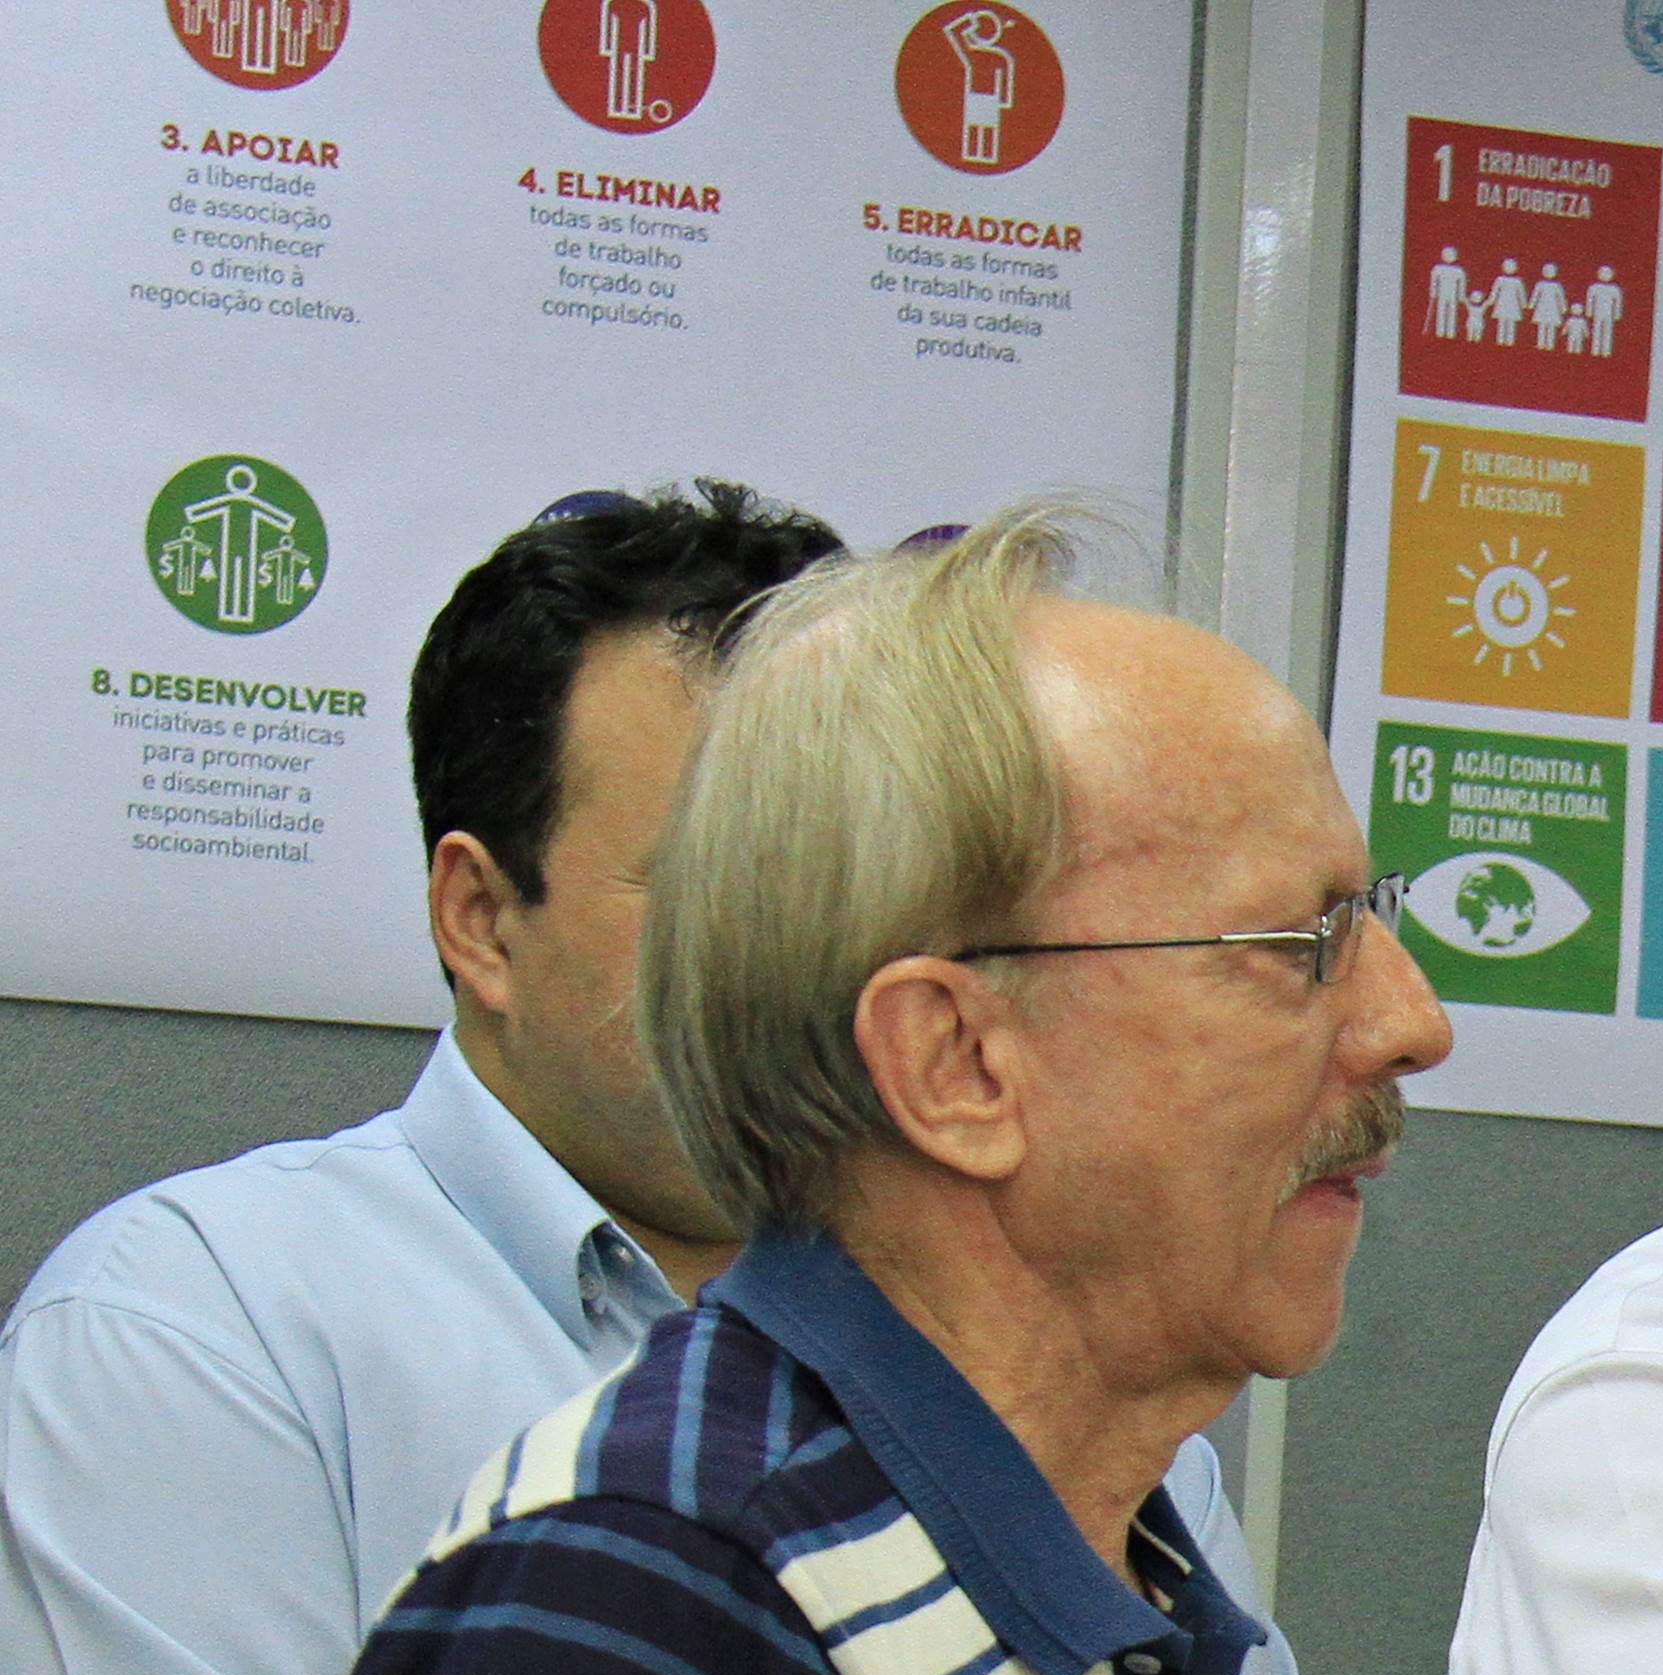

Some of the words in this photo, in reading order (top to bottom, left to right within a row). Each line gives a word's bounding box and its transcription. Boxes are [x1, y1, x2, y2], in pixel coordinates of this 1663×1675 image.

[161, 124, 189, 151] 3.
[201, 128, 339, 169] APOIAR
[187, 169, 199, 184] a
[207, 165, 316, 196] liberdade
[518, 168, 545, 193] 4.
[557, 171, 720, 213] ELIMINAR
[1434, 144, 1453, 202] 1
[169, 194, 196, 214] de
[204, 200, 332, 231] associação
[1476, 181, 1504, 208] DA
[1506, 186, 1593, 219] POBREZA
[173, 228, 186, 244] e
[194, 229, 326, 258] reconhecer
[530, 206, 591, 229] todas
[598, 216, 623, 233] as
[630, 214, 709, 243] formas
[862, 203, 889, 232] 5.
[898, 207, 1083, 253] ERRADICAR
[191, 260, 204, 276] o
[211, 258, 284, 284] direito
[554, 238, 581, 259] de
[589, 241, 681, 269] trabalho
[887, 243, 945, 268] todas
[950, 254, 975, 271] as
[982, 252, 1058, 280] formas
[559, 266, 641, 297] forçado
[649, 281, 676, 298] ou
[870, 271, 897, 292] de
[902, 274, 993, 302] trabalho
[999, 284, 1072, 310] infantil
[130, 283, 261, 316] negociação
[269, 297, 361, 323] coletiva.
[542, 299, 688, 330] compulsório.
[897, 303, 923, 324] da
[929, 311, 967, 328] sua
[974, 314, 1043, 337] cadeia
[916, 337, 1021, 363] produtiva.
[1418, 443, 1441, 502] 7
[91, 668, 118, 696] 8.
[129, 671, 367, 717] DESENVOLVER
[112, 705, 225, 735] iniciativas
[232, 721, 247, 738] e
[253, 719, 346, 747] práticas
[143, 743, 194, 765] para
[202, 747, 314, 772] promover
[1389, 745, 1435, 805] 13
[1452, 749, 1505, 779] AÇÃO
[1508, 754, 1585, 786] CONTRA
[1588, 763, 1603, 788] A
[142, 774, 155, 790] e
[163, 771, 293, 801] disseminar
[298, 787, 311, 804] a
[1450, 781, 1540, 814] MUDANÇA
[1542, 790, 1610, 822] GLOBAL
[126, 801, 325, 834] responsabilidade
[1448, 813, 1474, 839] DO
[1476, 815, 1532, 845] CLIMA
[132, 830, 314, 863] socioambiental.
